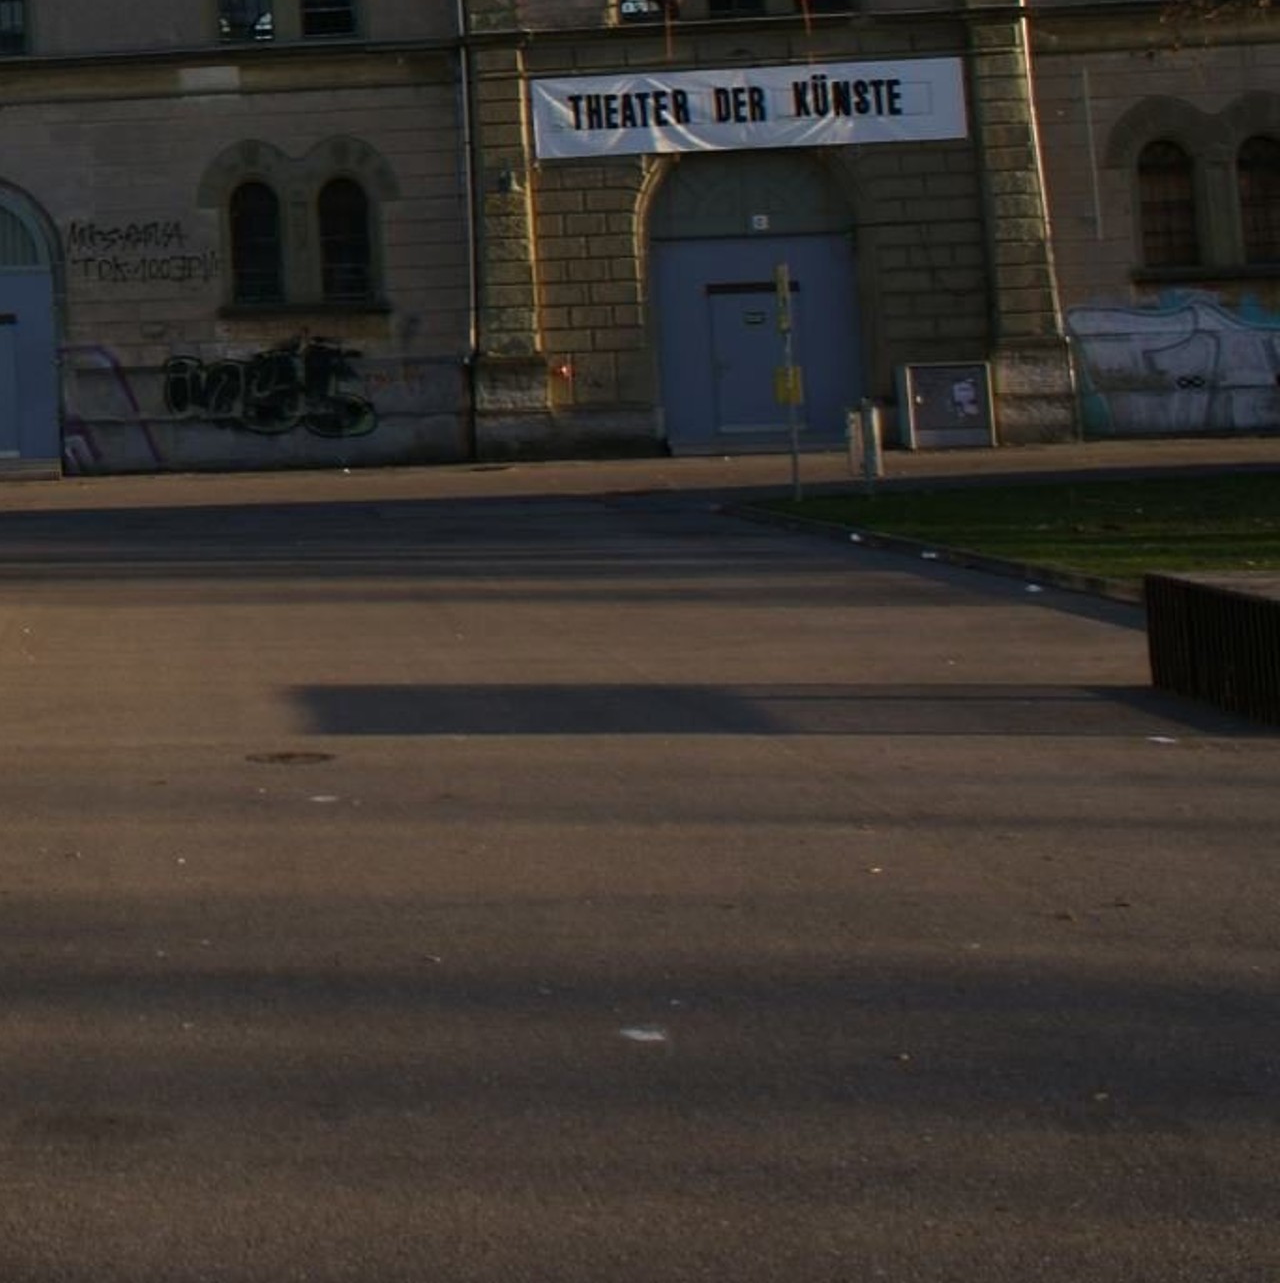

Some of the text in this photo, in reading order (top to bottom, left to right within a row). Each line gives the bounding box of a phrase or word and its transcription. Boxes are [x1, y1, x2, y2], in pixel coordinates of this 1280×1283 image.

[567, 74, 903, 132] THEATER DER KÜNSTE
